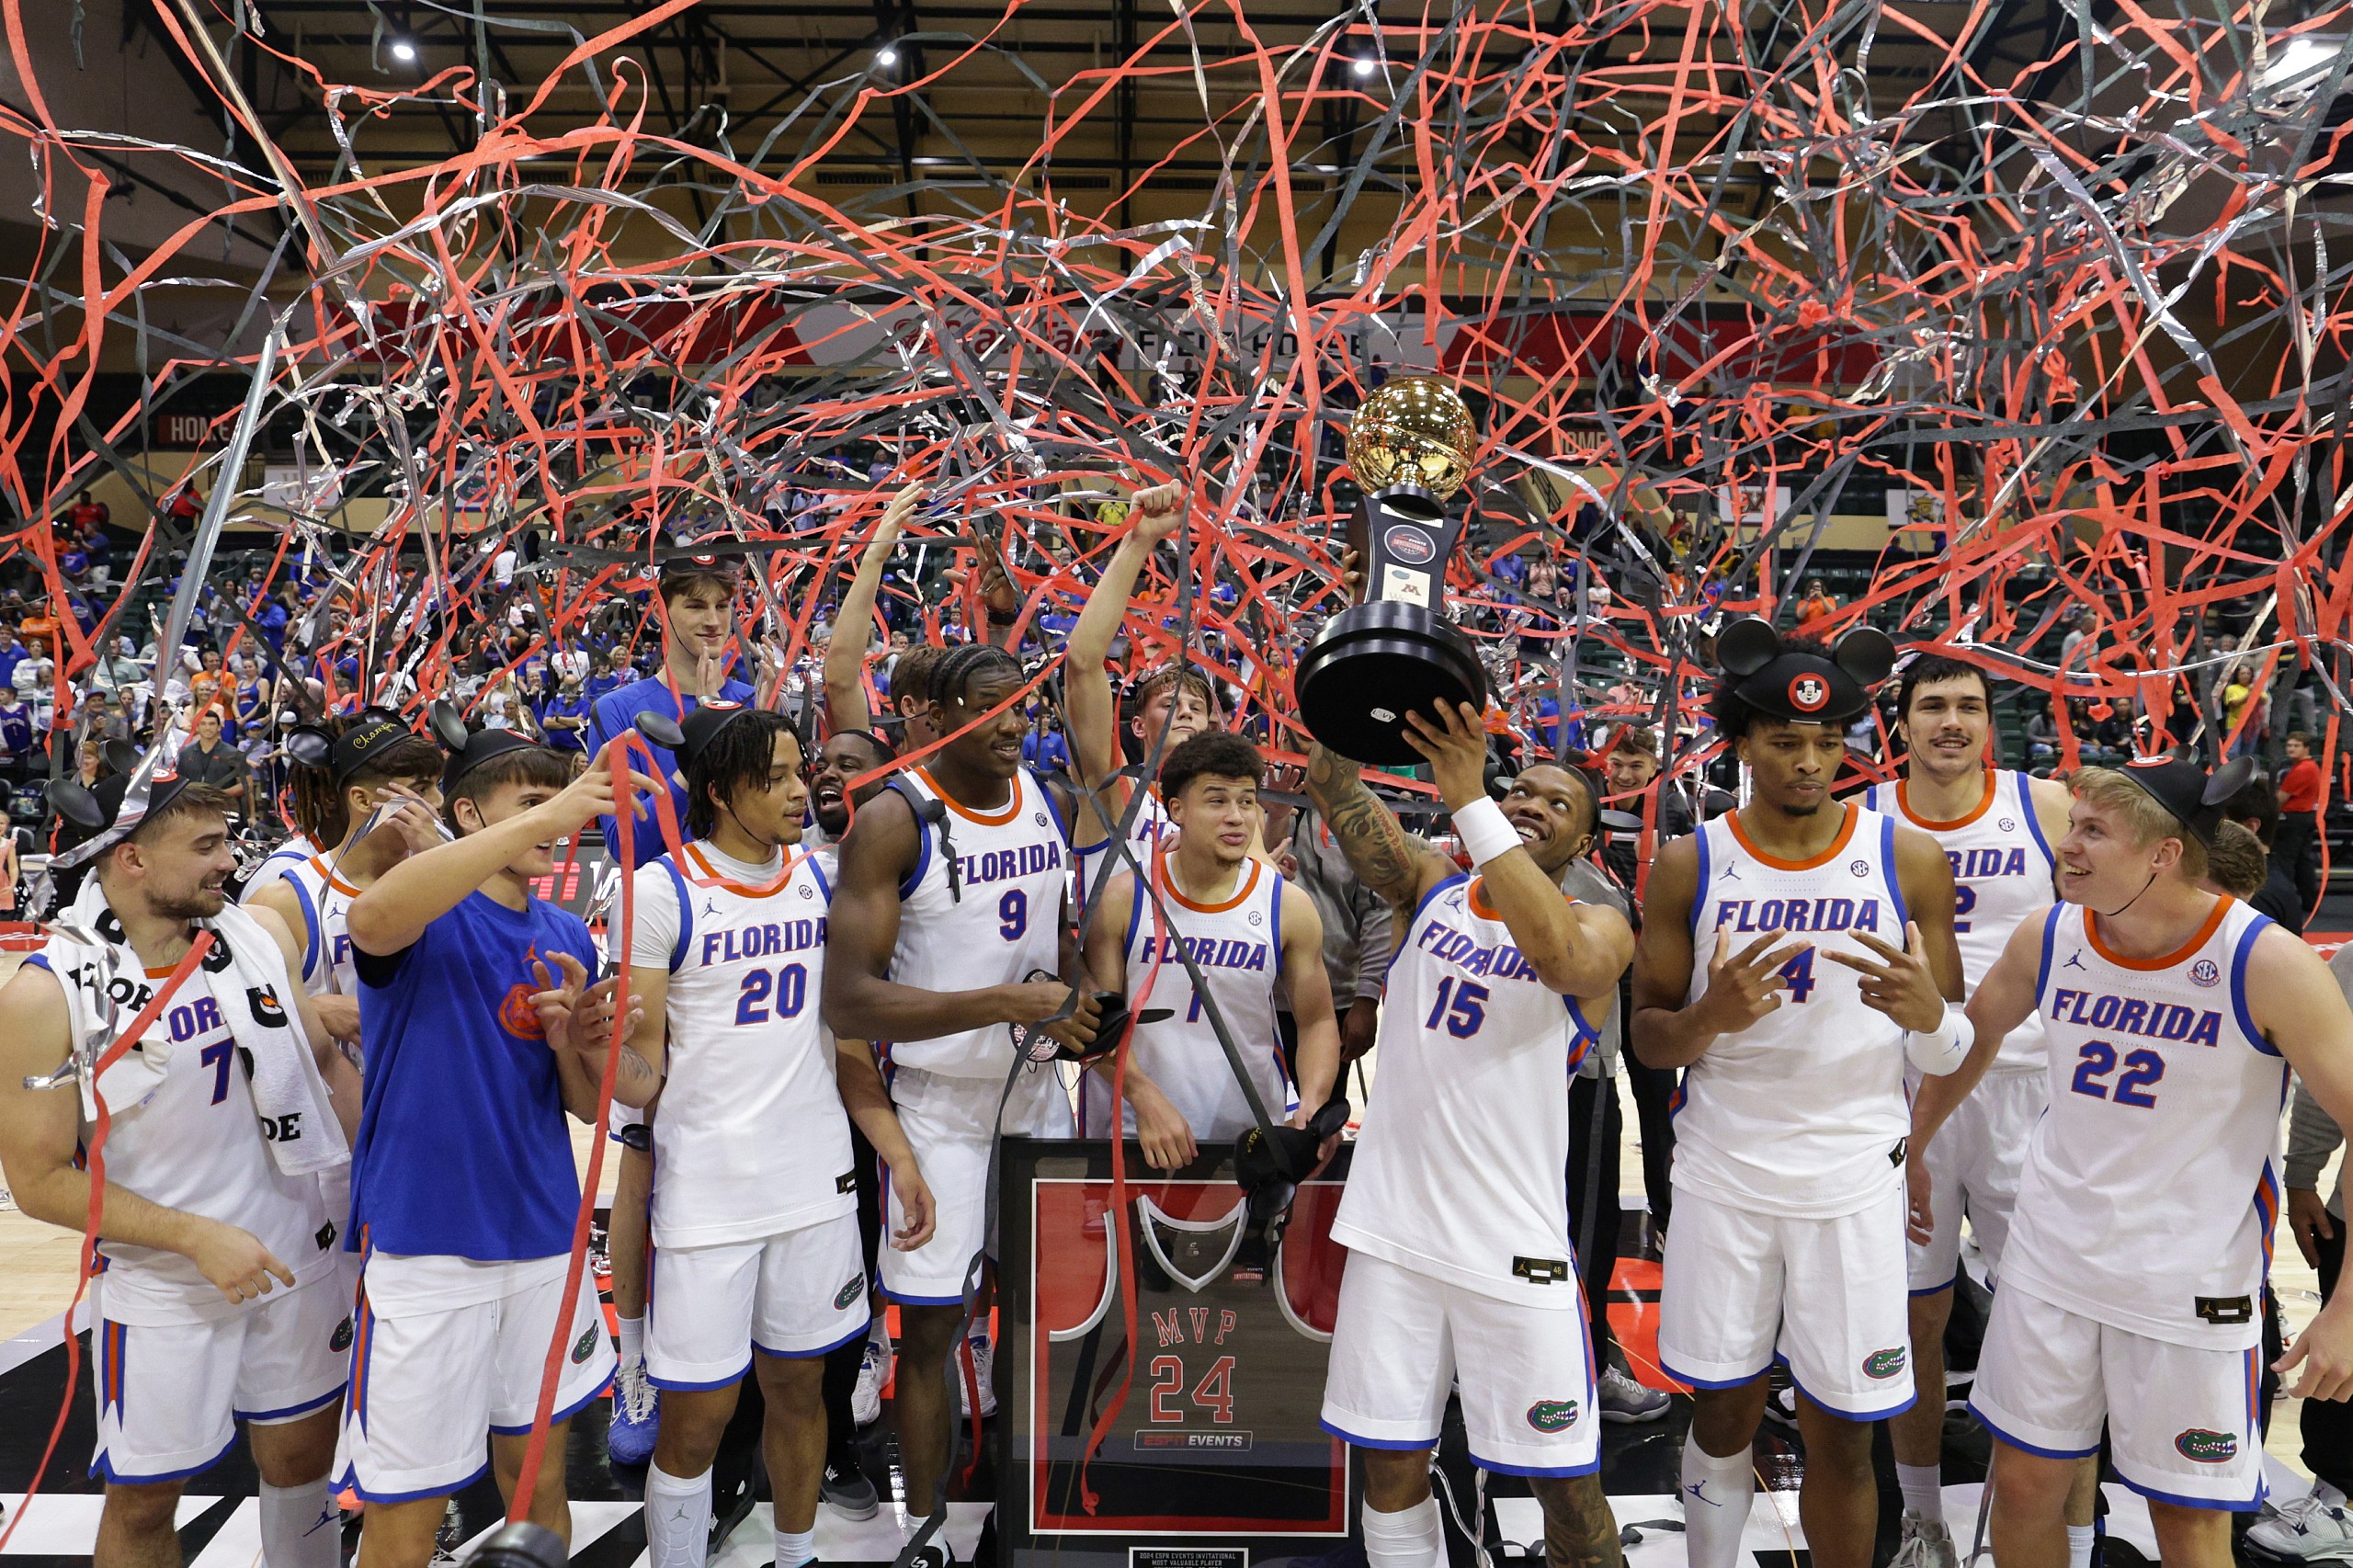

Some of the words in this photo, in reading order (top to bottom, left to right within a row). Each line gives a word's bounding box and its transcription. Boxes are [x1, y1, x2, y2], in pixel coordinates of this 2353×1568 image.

[1851, 862, 1869, 876] SEC
[1946, 847, 2026, 878] RIDA
[998, 888, 1028, 942] 9
[1712, 897, 1880, 934] FLORIDA
[699, 916, 827, 968] FLORIDA
[1140, 936, 1267, 971] FLORIDA
[1417, 919, 1538, 983] FLORIDA
[734, 962, 808, 1027] 20
[1774, 945, 1816, 1004] 4
[2195, 961, 2215, 980] SEC
[1425, 975, 1490, 1040] 15
[2051, 987, 2223, 1048] FLORIDA
[201, 1037, 235, 1107] 7
[2071, 1040, 2165, 1110] 22
[1152, 1307, 1237, 1347] MVP
[1150, 1355, 1235, 1423] 24
[1188, 1435, 1244, 1447] EVENTS
[1196, 1552, 1236, 1561] INVITATIONAL
